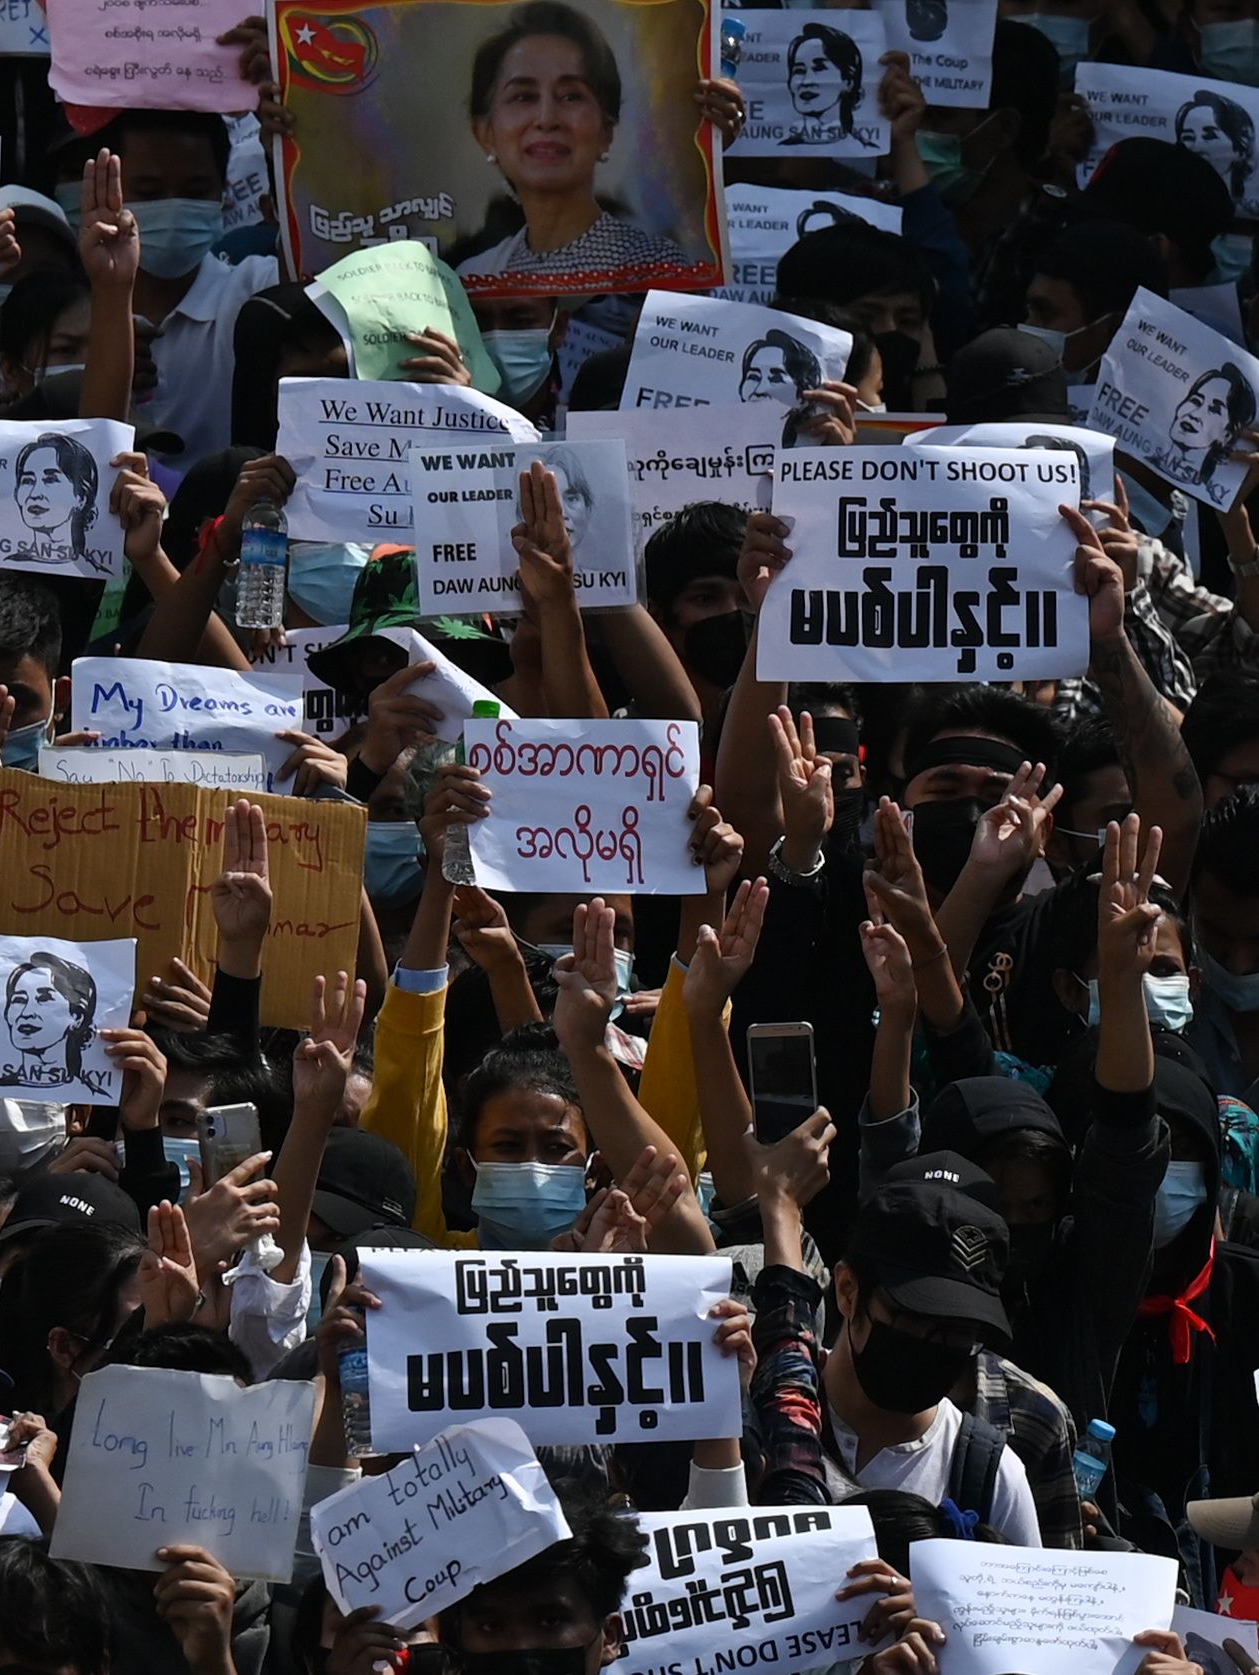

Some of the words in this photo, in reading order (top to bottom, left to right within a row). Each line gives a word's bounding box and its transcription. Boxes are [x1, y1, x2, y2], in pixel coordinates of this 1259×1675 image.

[936, 55, 968, 69] Coup
[934, 77, 984, 90] MILITARY
[1088, 90, 1106, 101] WE
[1111, 93, 1148, 106] WANT
[1116, 113, 1167, 127] LEADER
[854, 128, 880, 140] KYI
[733, 204, 768, 214] WANT
[739, 221, 789, 230] LEADER
[338, 264, 382, 281] SOLDIER
[655, 316, 678, 328] WE
[680, 320, 719, 337] WANT
[1138, 320, 1154, 335] WE
[1155, 330, 1187, 356] WANT
[650, 336, 678, 351] OUR
[682, 343, 735, 362] LEADER
[1127, 339, 1147, 355] OUR
[1148, 353, 1190, 383] LEADER
[321, 400, 357, 421] We
[364, 402, 424, 425] Want
[1099, 382, 1149, 425] FREE
[325, 435, 380, 458] Save
[1114, 423, 1151, 453] AUNG
[421, 455, 453, 470] WE
[459, 453, 515, 469] WANT
[781, 461, 853, 482] PLEASE
[862, 461, 940, 480] DON'T
[947, 461, 1030, 481] SHOOT
[1038, 463, 1076, 483] US!
[324, 469, 375, 492] Free
[428, 491, 459, 503] OUR
[462, 489, 513, 501] LEADER
[368, 505, 398, 527] Su
[838, 497, 1009, 558] ပြည်သူတွေကို
[433, 543, 477, 562] FREE
[433, 578, 473, 595] DAW
[600, 571, 626, 588] KYI
[92, 682, 143, 730] My
[155, 683, 252, 714] Dreams
[264, 700, 297, 717] are
[469, 720, 686, 800] စစ်အာဏာရှင်
[515, 805, 645, 884] အလိုမရှိ
[11, 864, 160, 930] Save
[925, 1170, 960, 1182] NONE
[60, 1194, 95, 1216] NONE
[455, 1257, 646, 1314] ပြည်သူတွေကို
[92, 1399, 148, 1469] Long
[169, 1411, 193, 1458] live
[328, 1512, 370, 1545] am
[388, 1435, 475, 1505] totally
[135, 1483, 165, 1521] In
[335, 1518, 422, 1598] Against
[427, 1475, 506, 1530] Military
[404, 1559, 461, 1603] Coup
